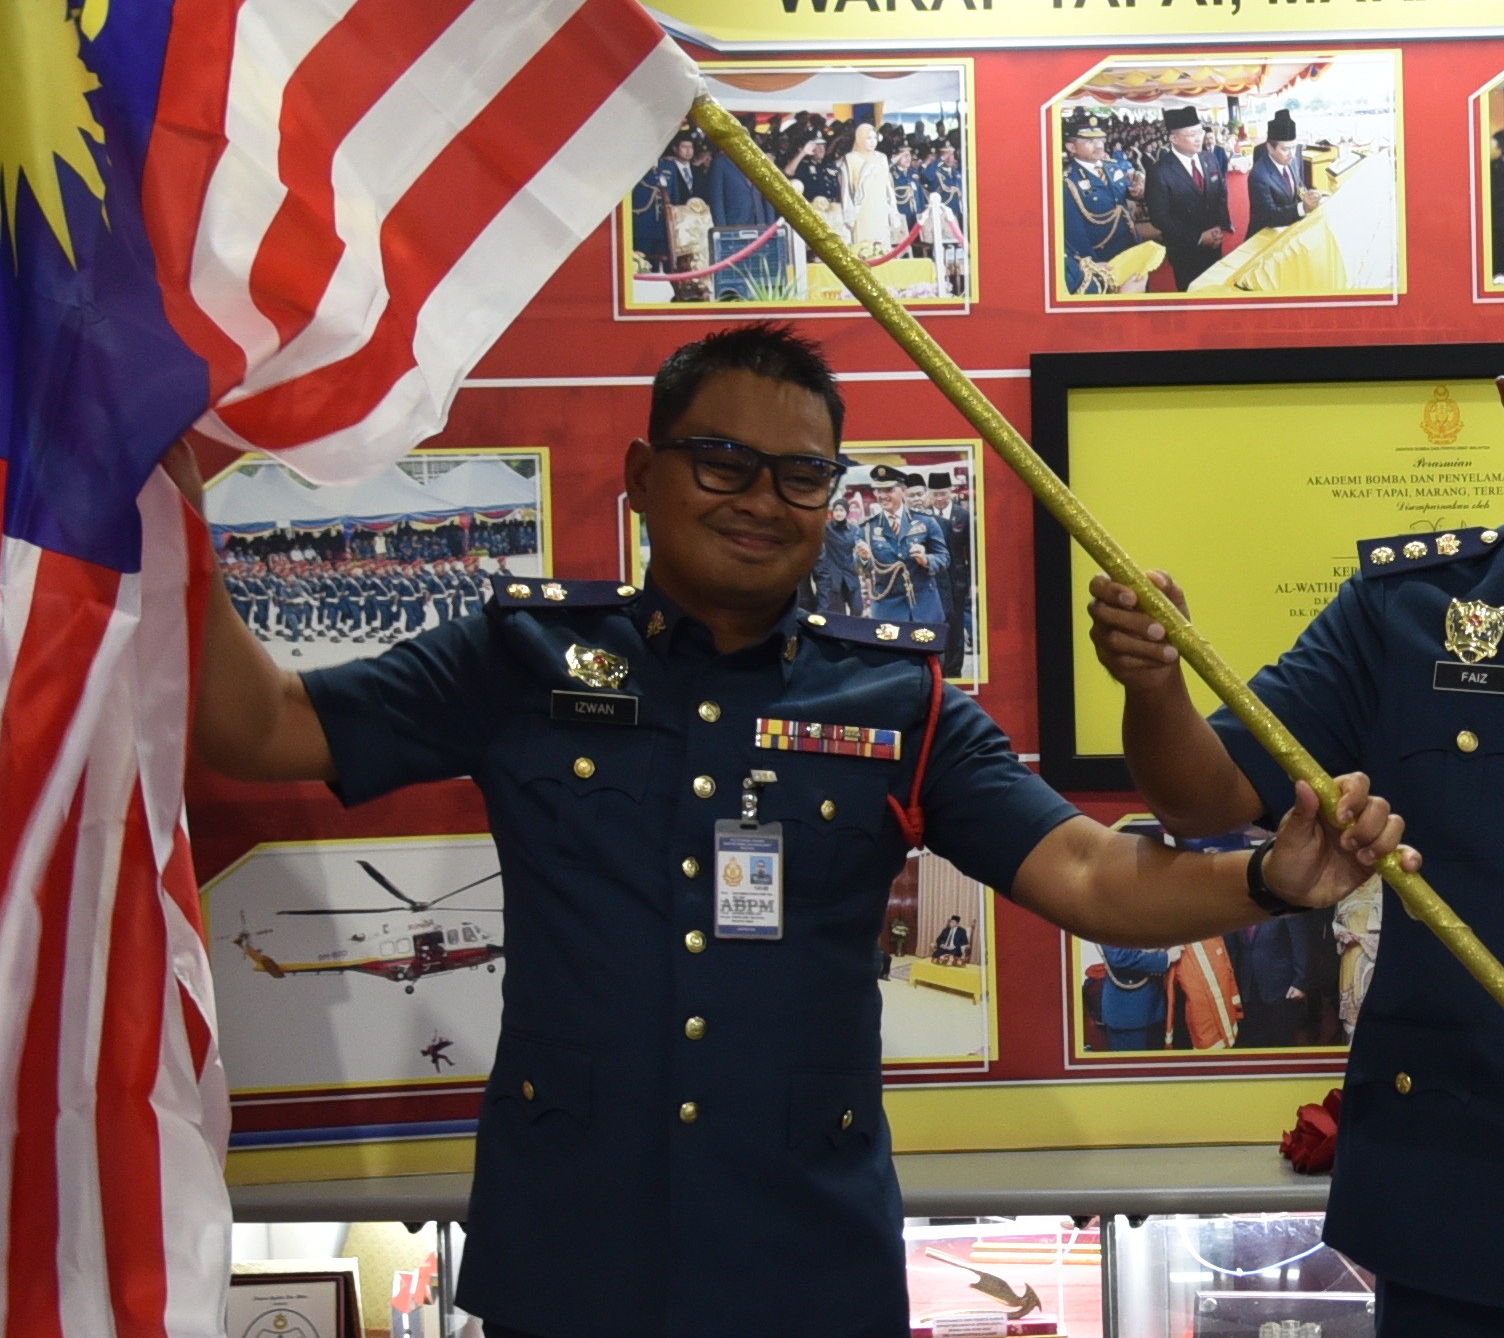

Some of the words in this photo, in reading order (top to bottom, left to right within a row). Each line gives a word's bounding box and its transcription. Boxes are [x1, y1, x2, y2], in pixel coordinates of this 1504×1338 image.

[1412, 457, 1473, 468] Perasmian
[1306, 475, 1363, 486] AKADEMI
[1365, 474, 1407, 485] BOMBA
[1410, 473, 1435, 484] DAN
[1331, 488, 1373, 498] WAKAF
[1375, 487, 1413, 499] TAPAI,
[1415, 486, 1470, 498] MARANG,
[1275, 582, 1339, 594] AL-WATHI
[1460, 671, 1488, 684] FAIZ
[574, 701, 616, 716] IZWAN
[720, 898, 775, 914] ABPM
